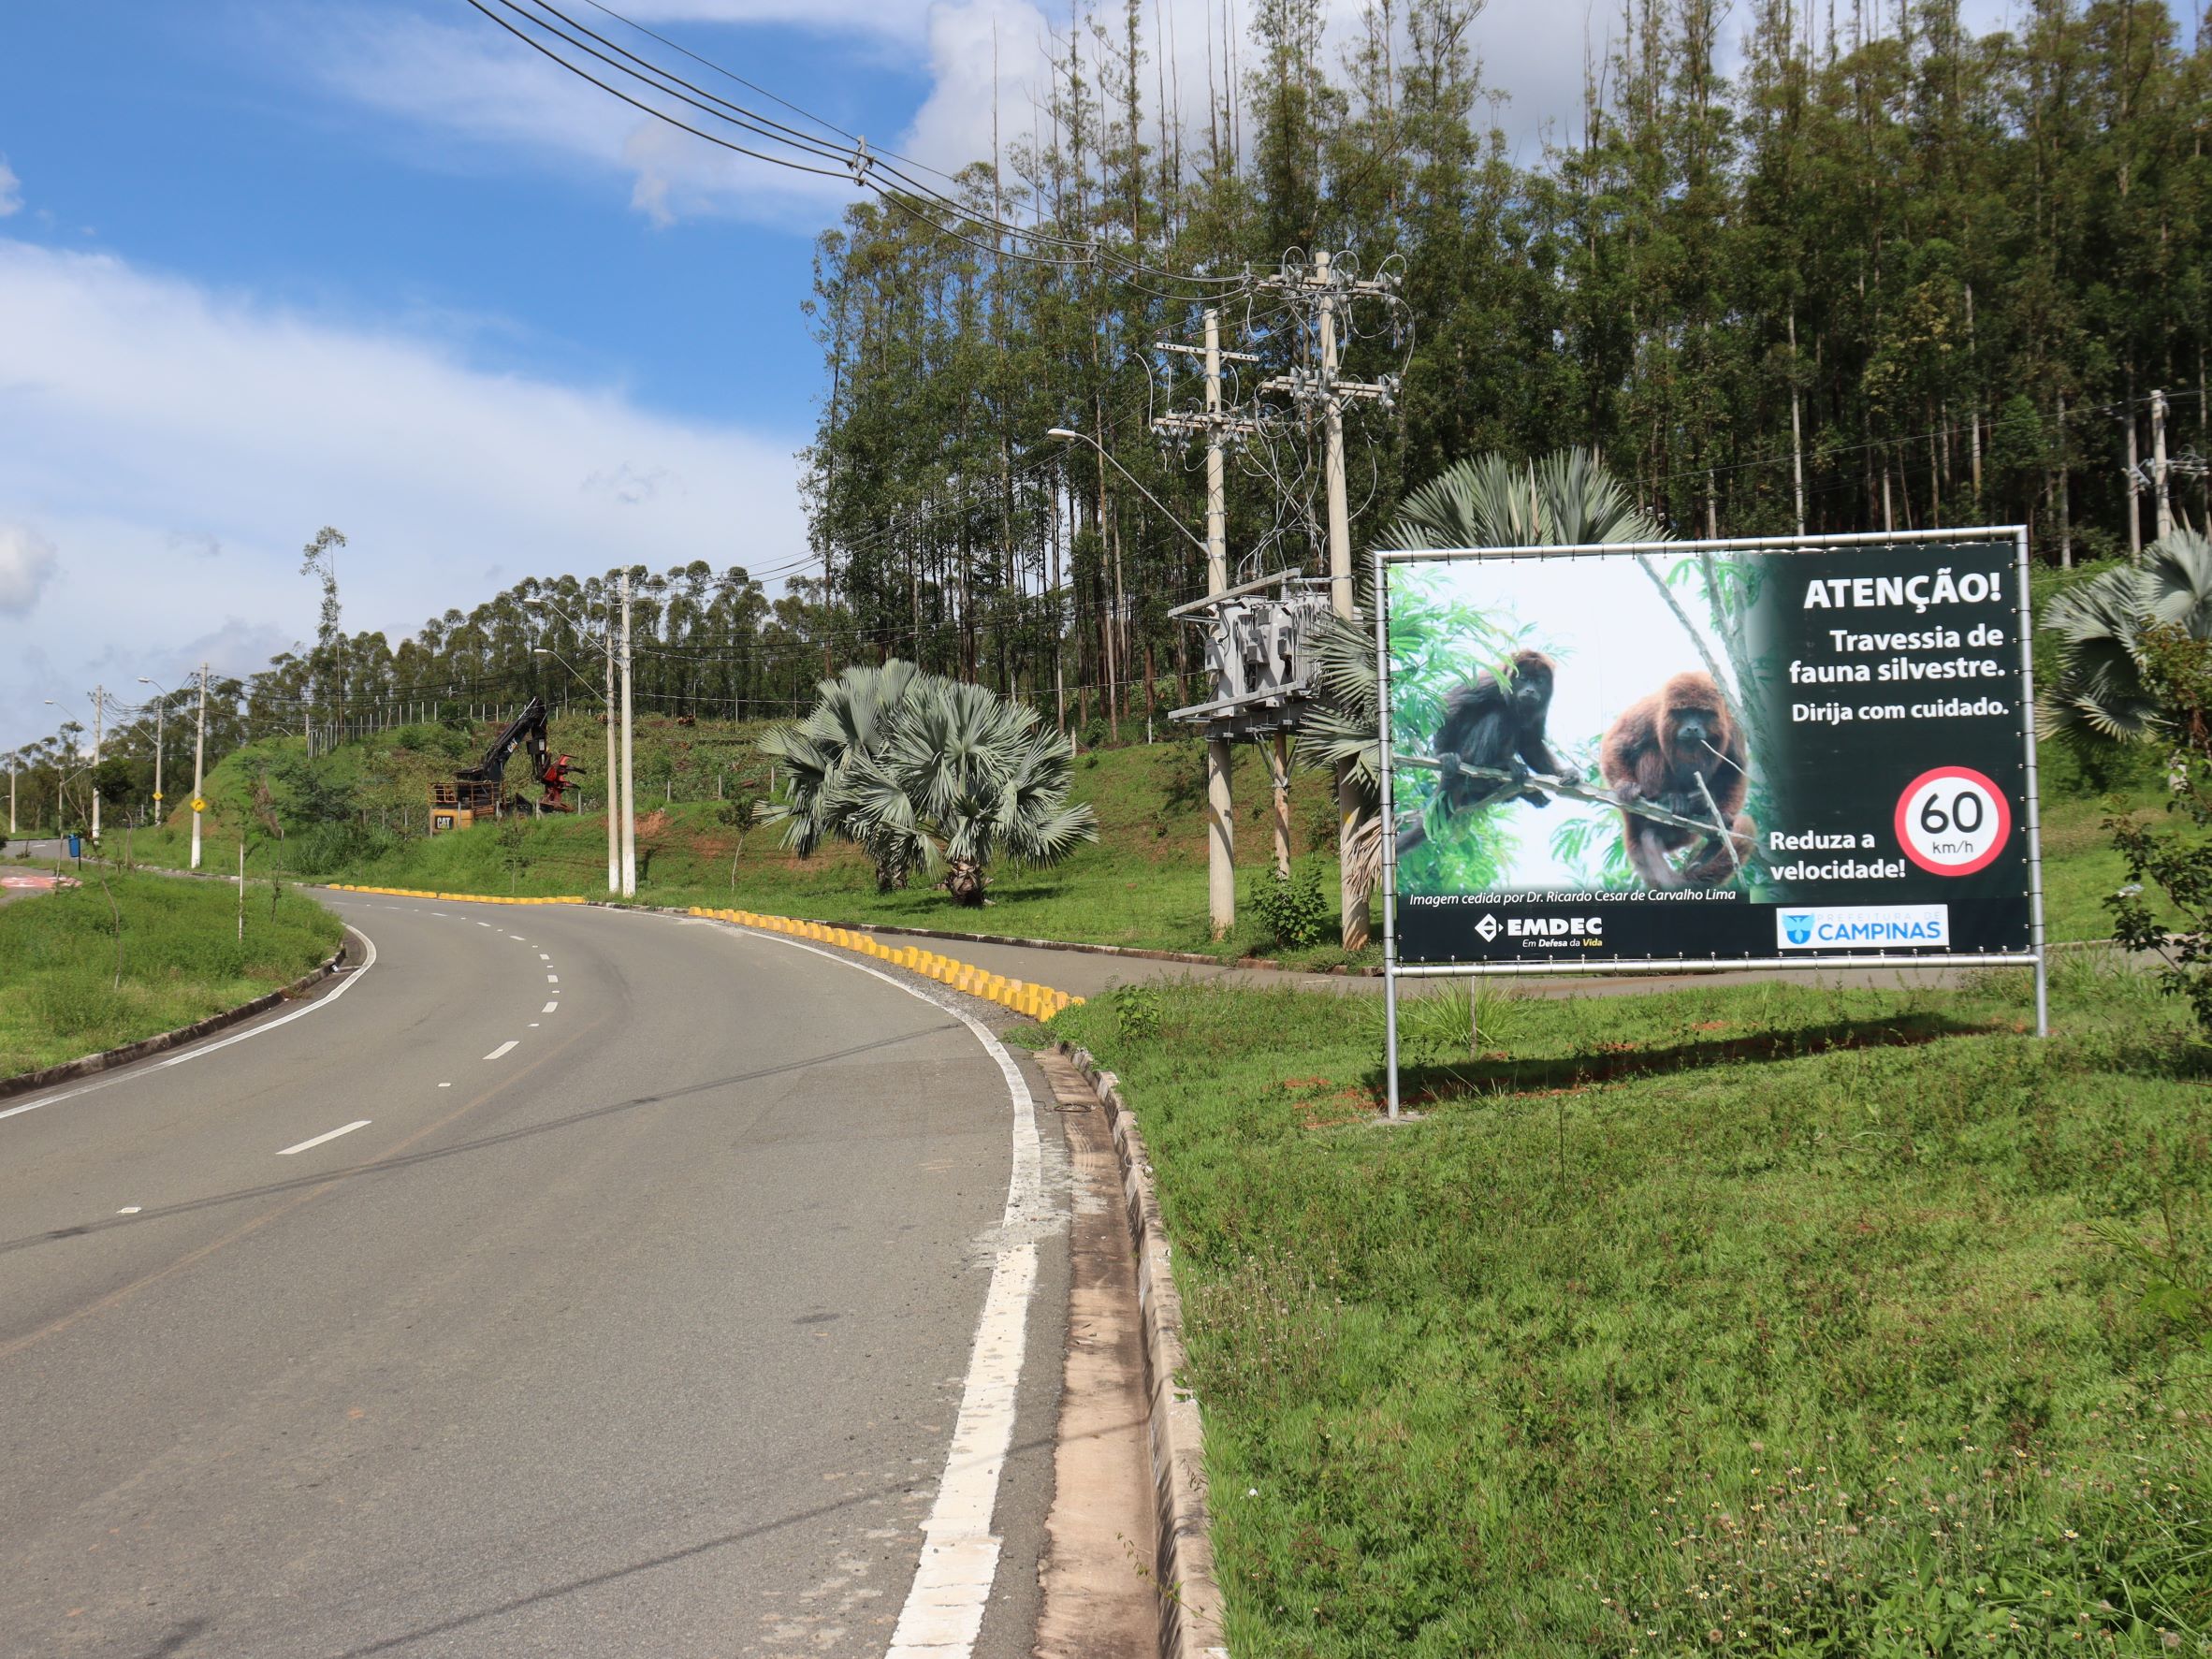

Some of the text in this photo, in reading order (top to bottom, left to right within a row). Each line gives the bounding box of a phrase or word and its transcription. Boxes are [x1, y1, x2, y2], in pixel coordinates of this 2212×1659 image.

[1804, 567, 2001, 613] ATENÇÃO!
[1829, 623, 2004, 652] Travessia de
[1789, 657, 2006, 683] fauna silvestre.
[1792, 697, 2009, 725] Dirija com cuidado.
[437, 817, 451, 829] CAT
[1920, 791, 1983, 835] 60
[1769, 830, 1875, 851] Reduza a
[1932, 840, 1973, 853] km/h
[1770, 859, 1906, 880] velocidade!
[1409, 889, 1737, 907] Imagem cedida por Dr. Ricardo Cesar de Carvalho Lima
[1507, 918, 1602, 936] EMDEC
[1818, 922, 1942, 940] CAMPINAS
[1522, 938, 1603, 948] Em Defesa da Vida
